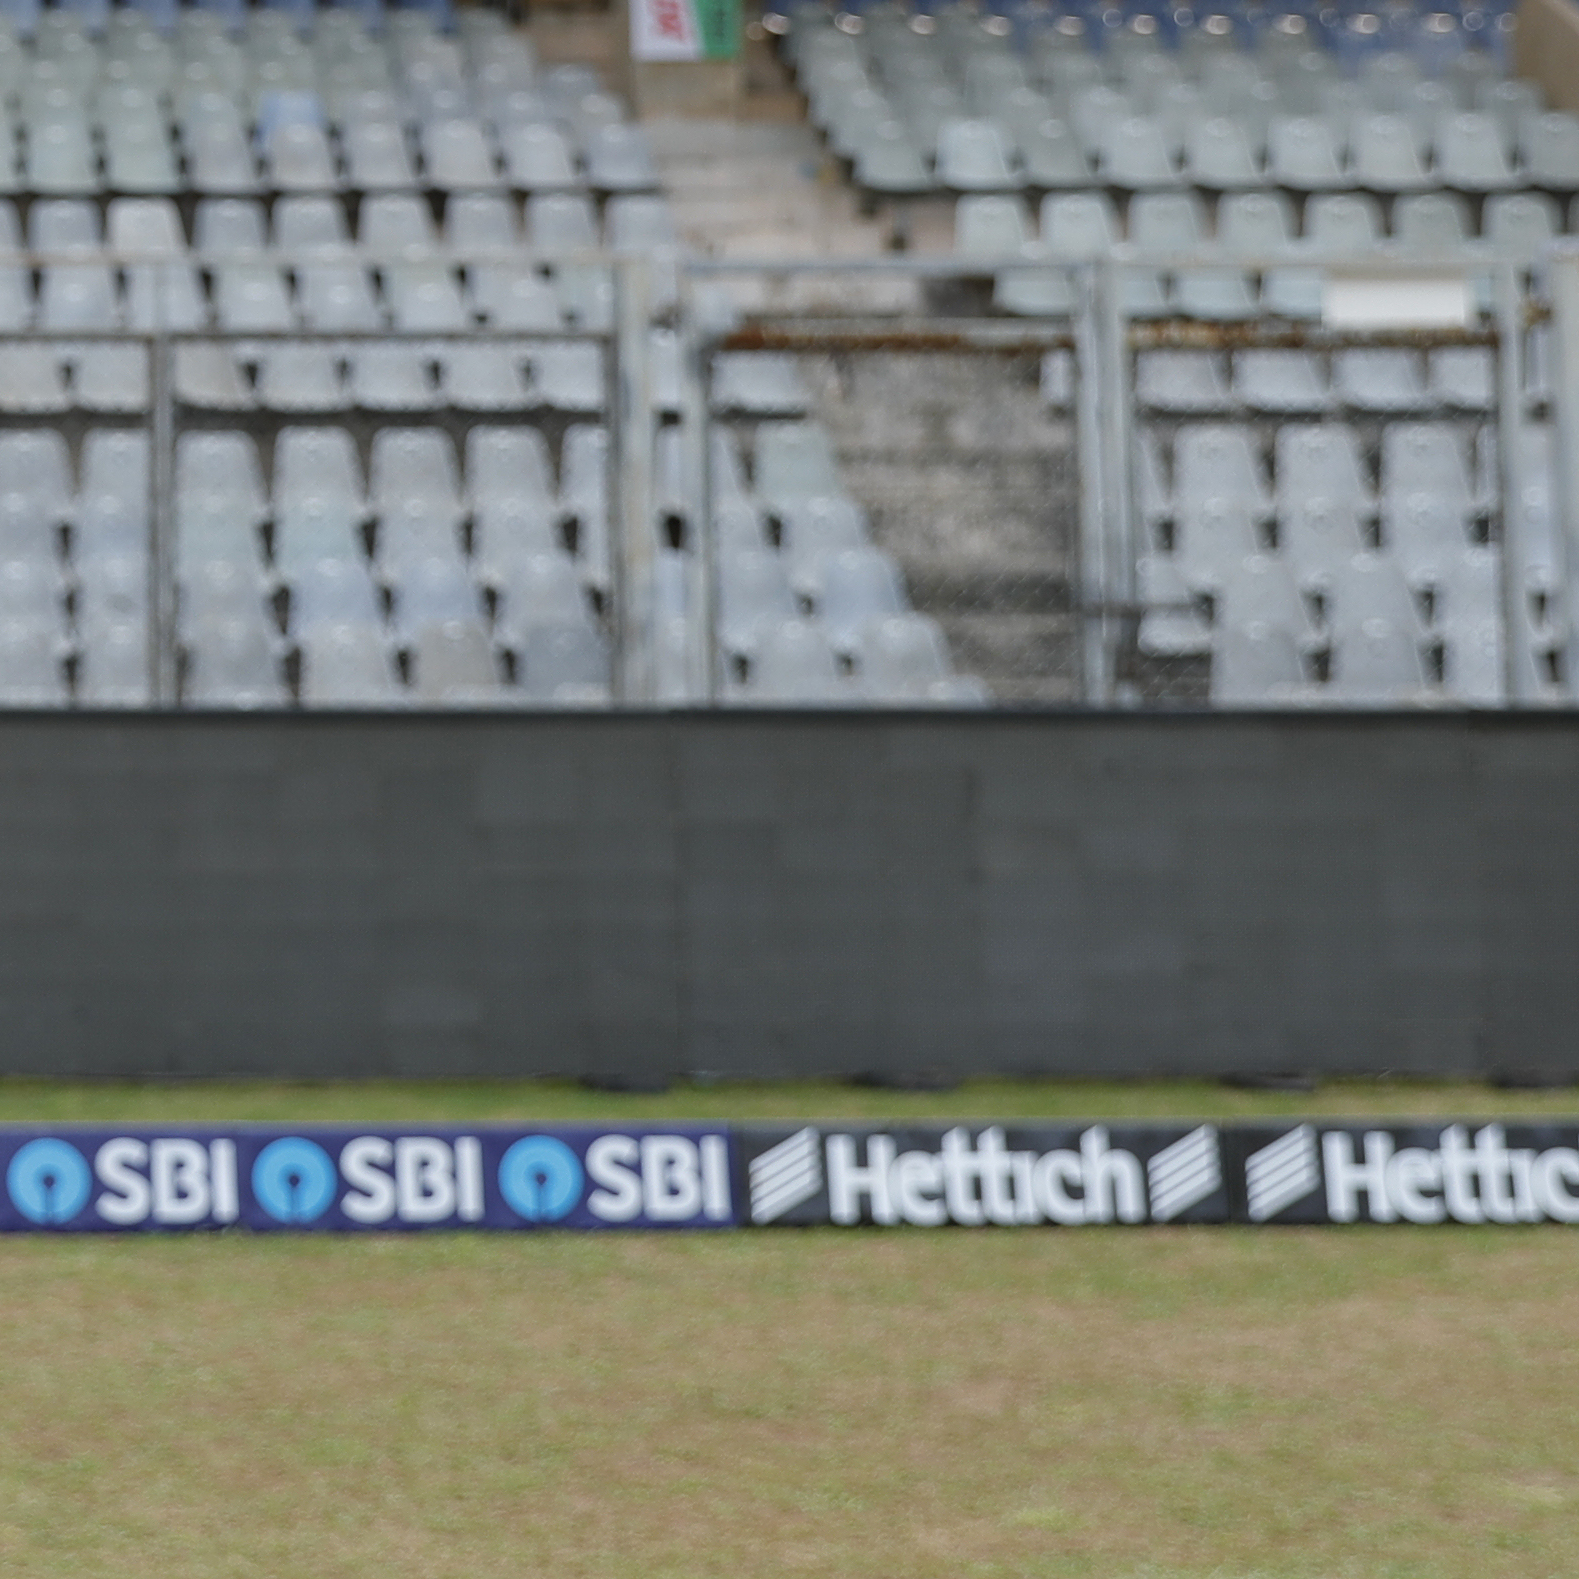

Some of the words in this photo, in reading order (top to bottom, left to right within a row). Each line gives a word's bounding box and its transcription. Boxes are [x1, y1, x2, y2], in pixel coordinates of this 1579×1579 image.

[93, 1136, 240, 1225] SBI
[338, 1134, 485, 1224] SBI
[584, 1132, 731, 1223] SBI
[823, 1123, 1149, 1226] Hettich
[1322, 1122, 1579, 1225] Hettic
